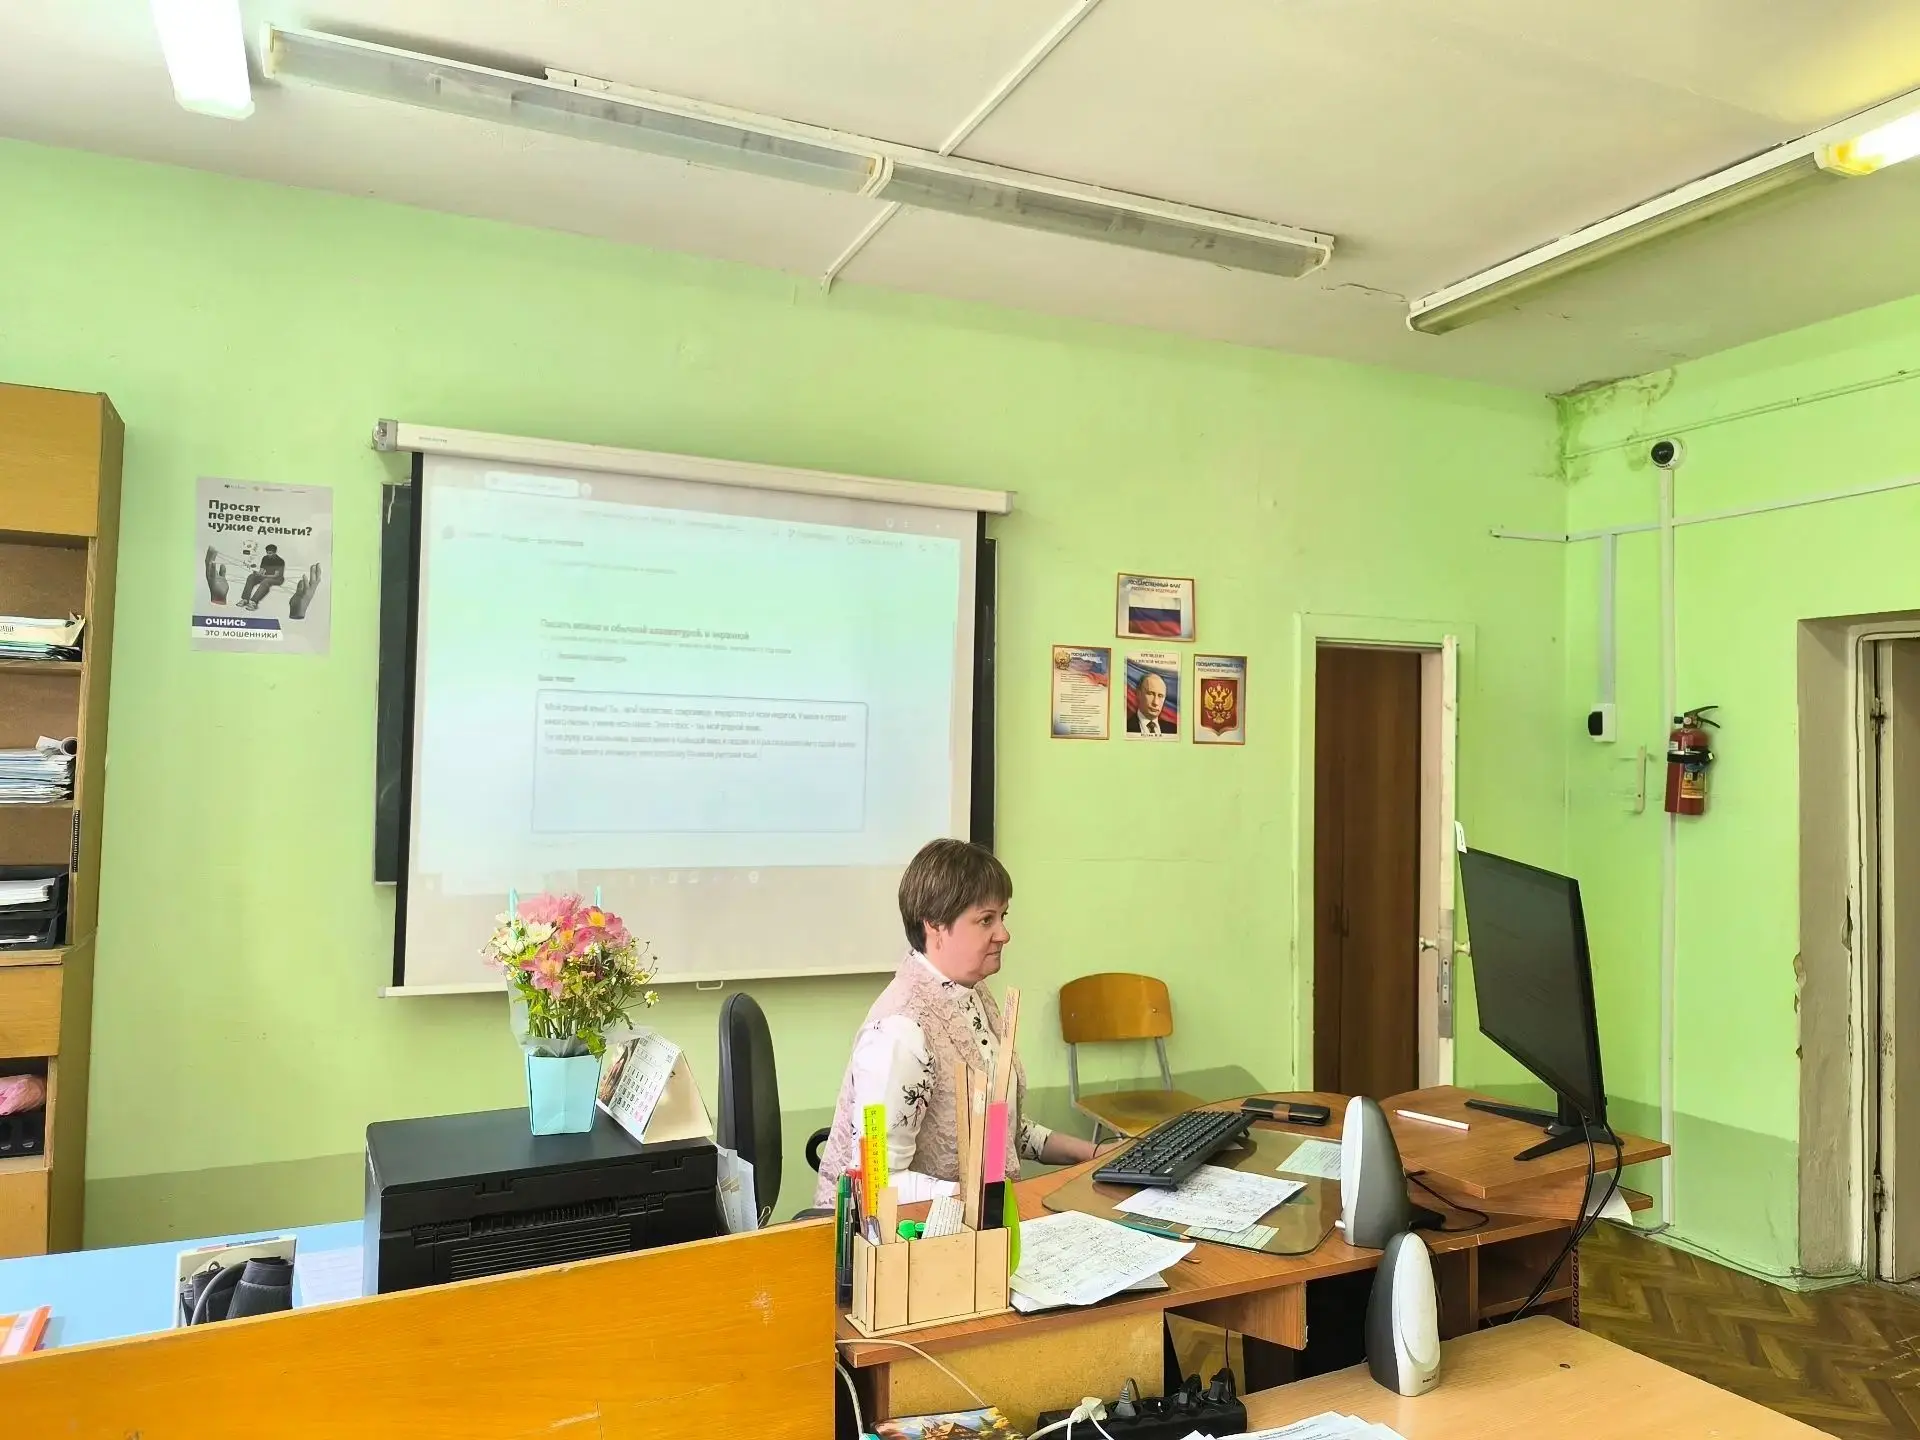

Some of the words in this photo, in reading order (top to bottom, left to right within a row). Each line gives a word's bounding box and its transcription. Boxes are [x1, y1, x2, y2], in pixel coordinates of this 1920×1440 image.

[208, 499, 261, 513] Просят
[208, 512, 281, 525] перевести
[208, 521, 254, 533] чужие
[257, 525, 313, 536] деньги?
[205, 617, 247, 627] очнись
[204, 629, 220, 637] это
[222, 631, 278, 639] мошенники
